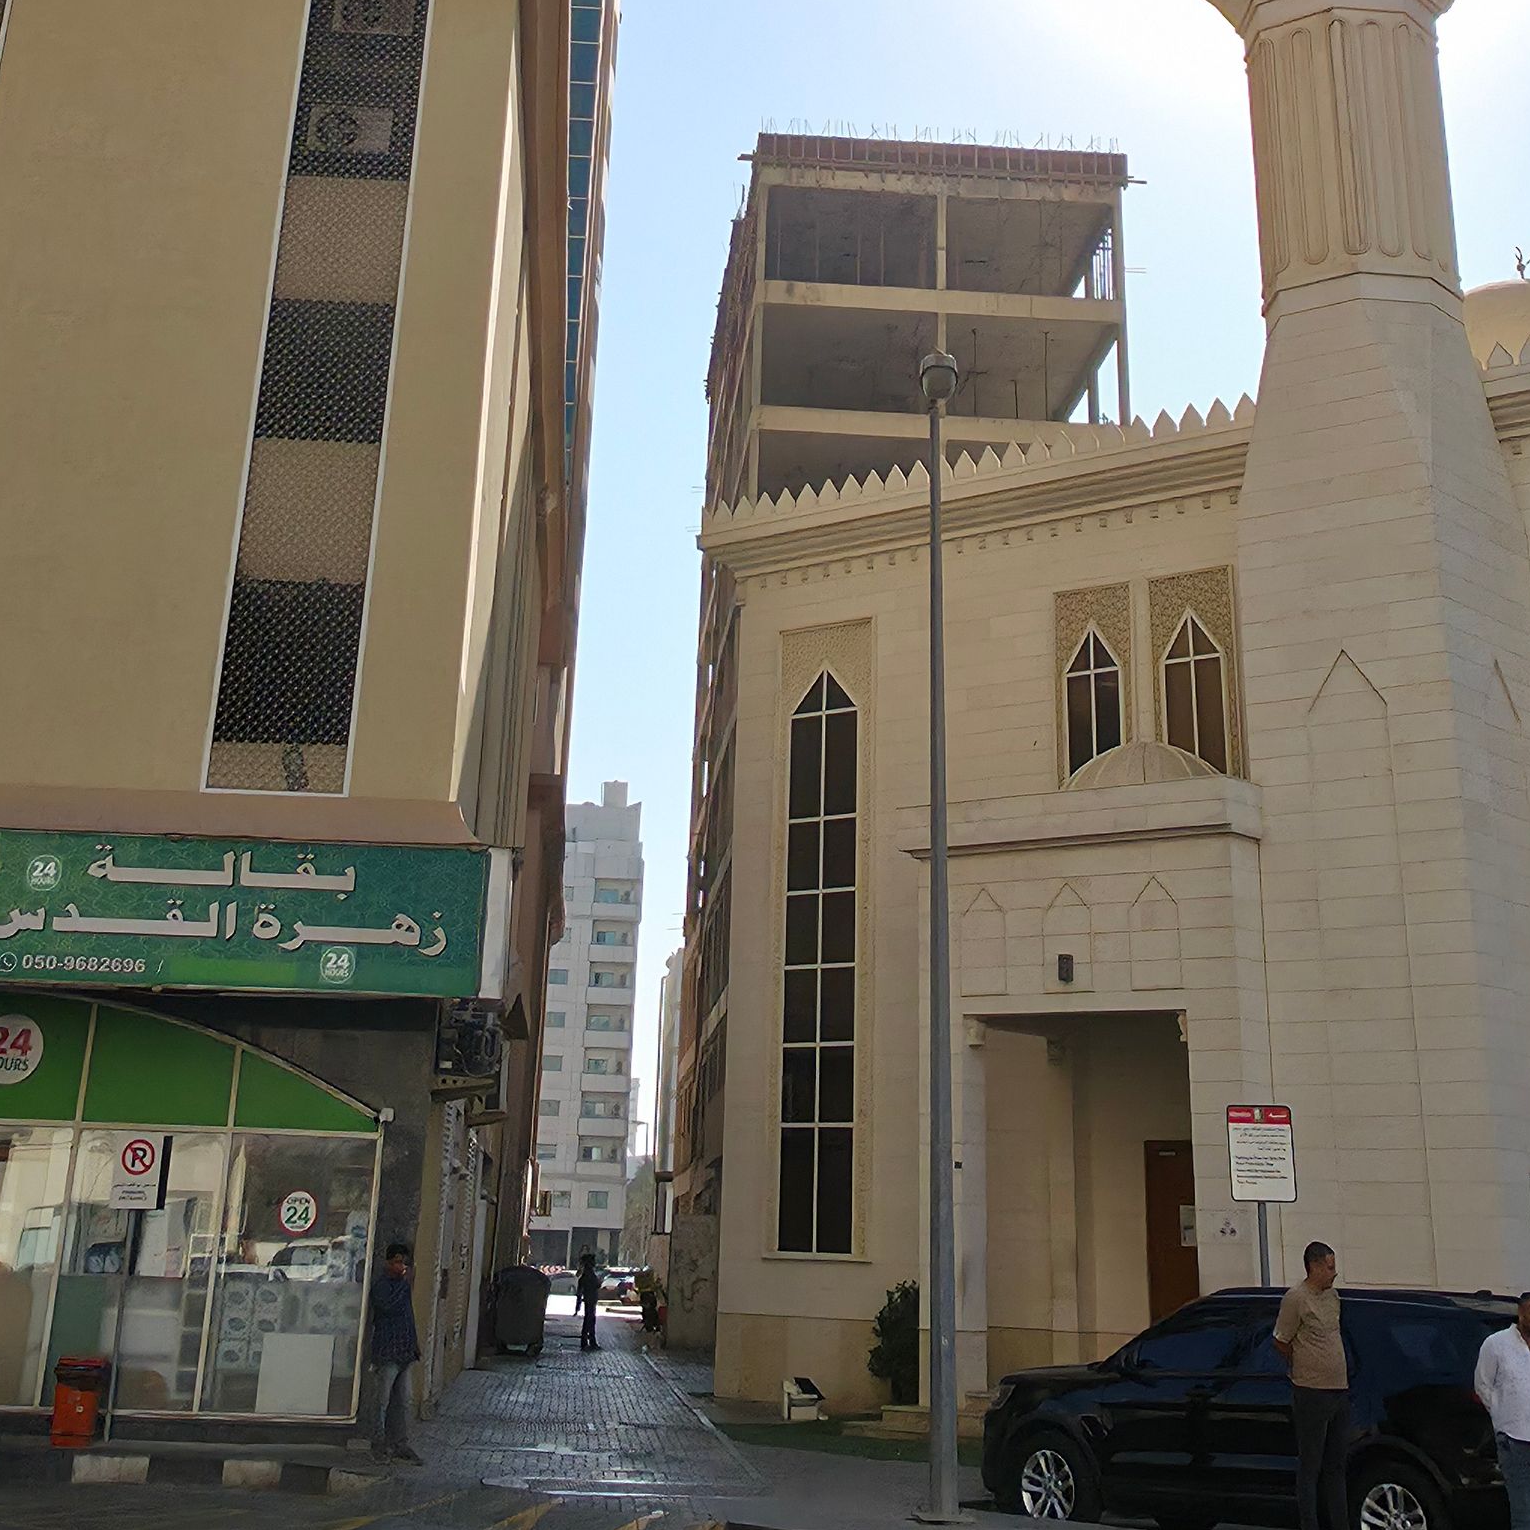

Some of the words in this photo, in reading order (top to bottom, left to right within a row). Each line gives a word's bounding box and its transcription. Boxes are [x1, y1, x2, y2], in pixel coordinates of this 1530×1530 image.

[32, 860, 57, 877] 24
[85, 842, 357, 901] بقالة
[251, 902, 448, 957] زهرة
[21, 954, 147, 975] 050-9682696
[326, 952, 350, 970] 24
[284, 1205, 311, 1225] 24
